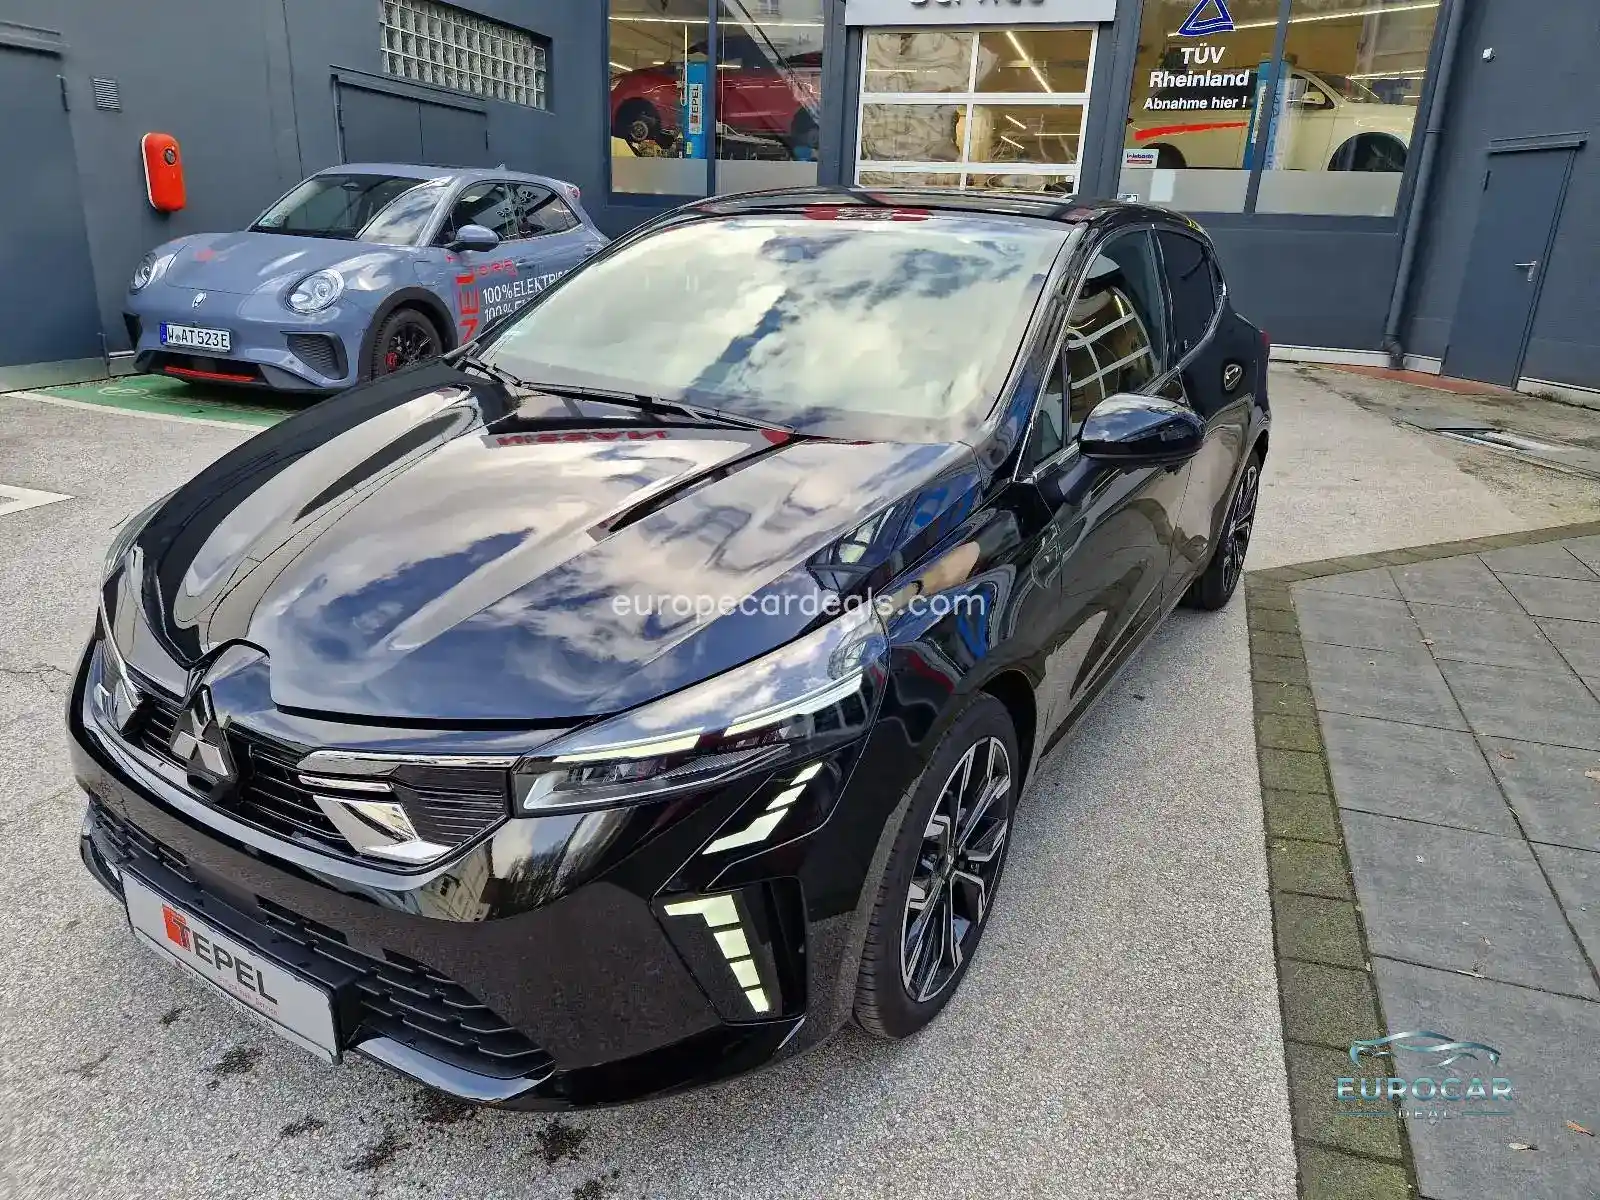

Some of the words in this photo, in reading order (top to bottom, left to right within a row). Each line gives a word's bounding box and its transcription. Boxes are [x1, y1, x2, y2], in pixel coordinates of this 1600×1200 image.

[1181, 42, 1226, 64] TÜV
[1149, 69, 1250, 88] Rheinland
[1143, 96, 1208, 110] Abnahme
[1211, 96, 1239, 109] hier
[169, 911, 278, 1005] TEPEL
